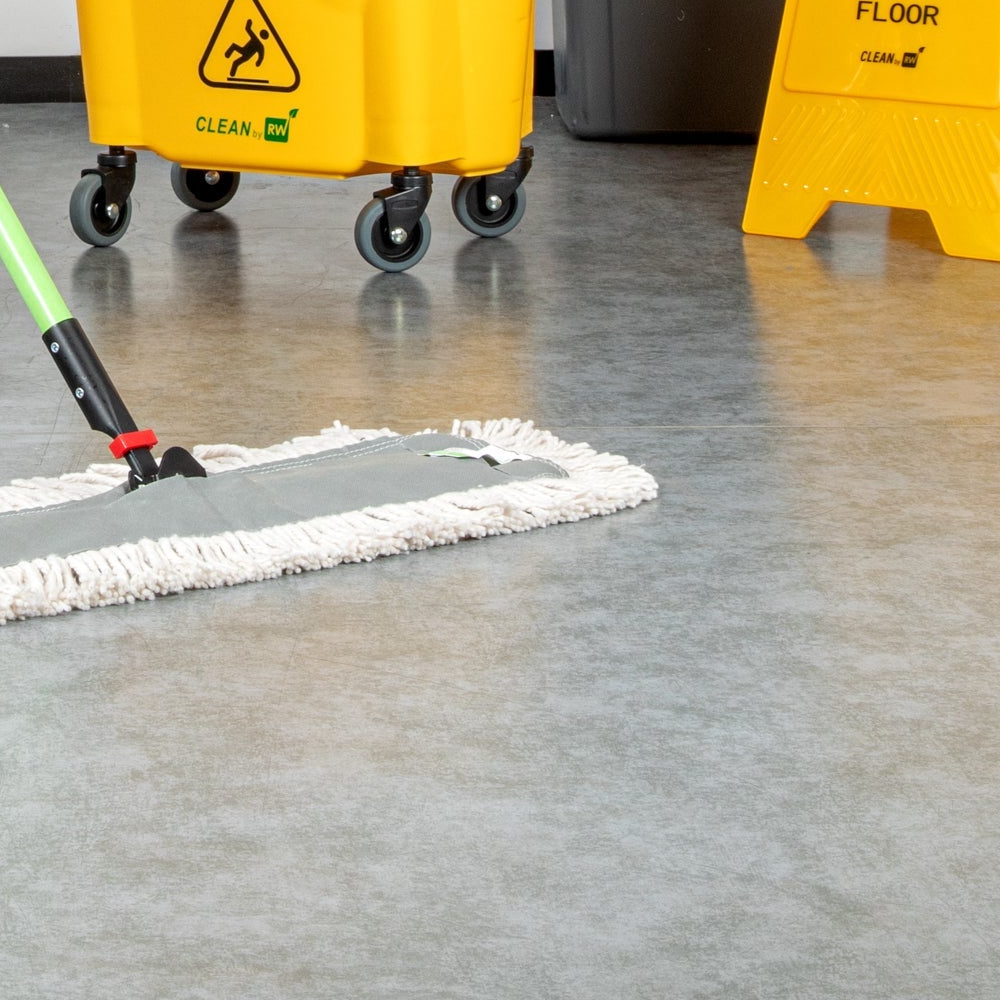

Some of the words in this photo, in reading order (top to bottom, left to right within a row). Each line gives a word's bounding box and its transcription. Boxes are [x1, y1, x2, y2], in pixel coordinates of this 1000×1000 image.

[856, 0, 940, 26] FLOOR
[860, 50, 895, 64] CLEAN
[196, 116, 252, 137] CLEAN
[252, 130, 263, 140] by
[267, 121, 288, 137] RW
